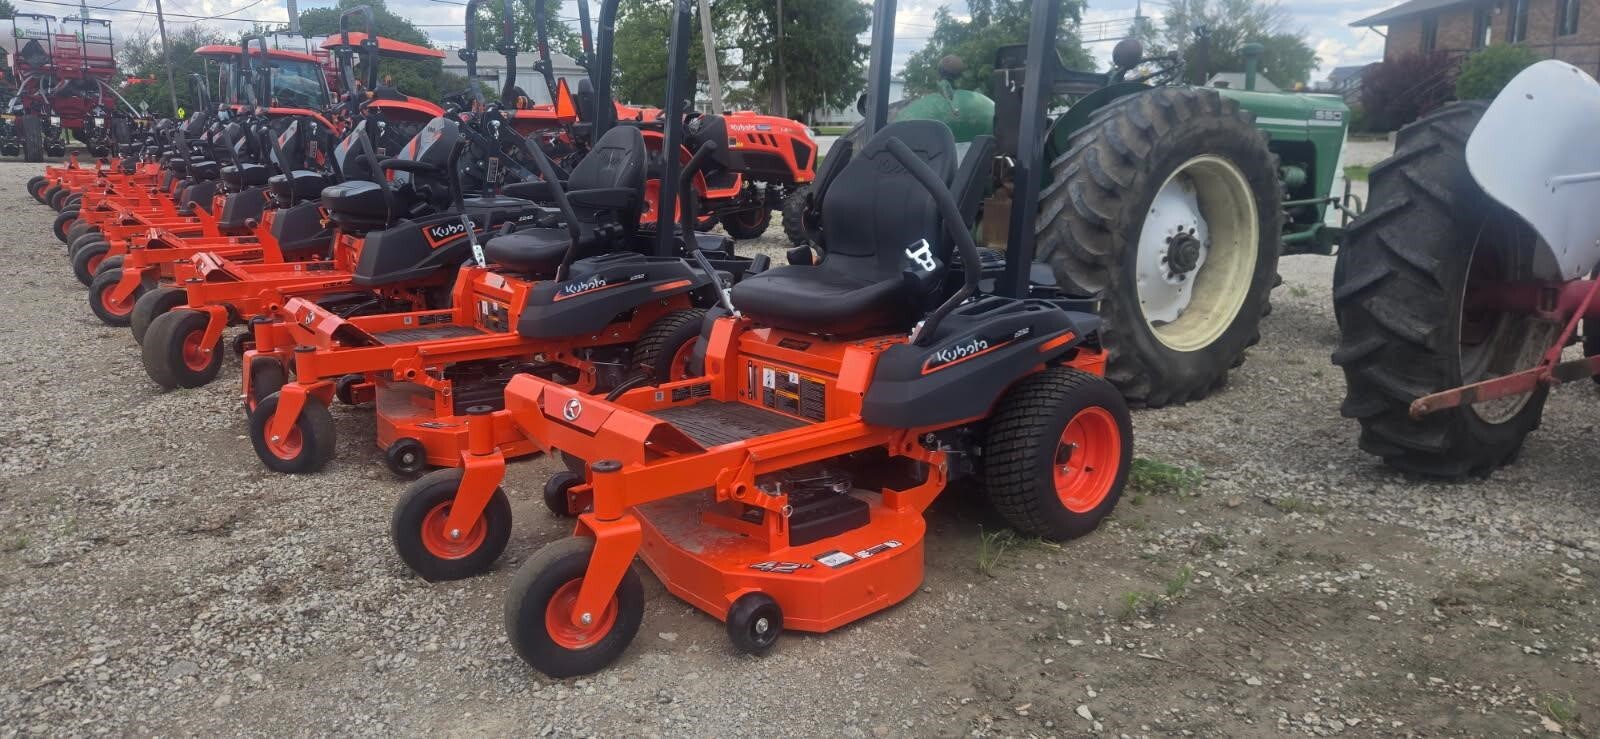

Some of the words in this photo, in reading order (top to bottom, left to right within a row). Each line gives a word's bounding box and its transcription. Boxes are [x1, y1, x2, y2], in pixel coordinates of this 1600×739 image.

[432, 220, 476, 237] Kuboa
[565, 278, 607, 294] Kubota
[937, 339, 988, 362] Kubota
